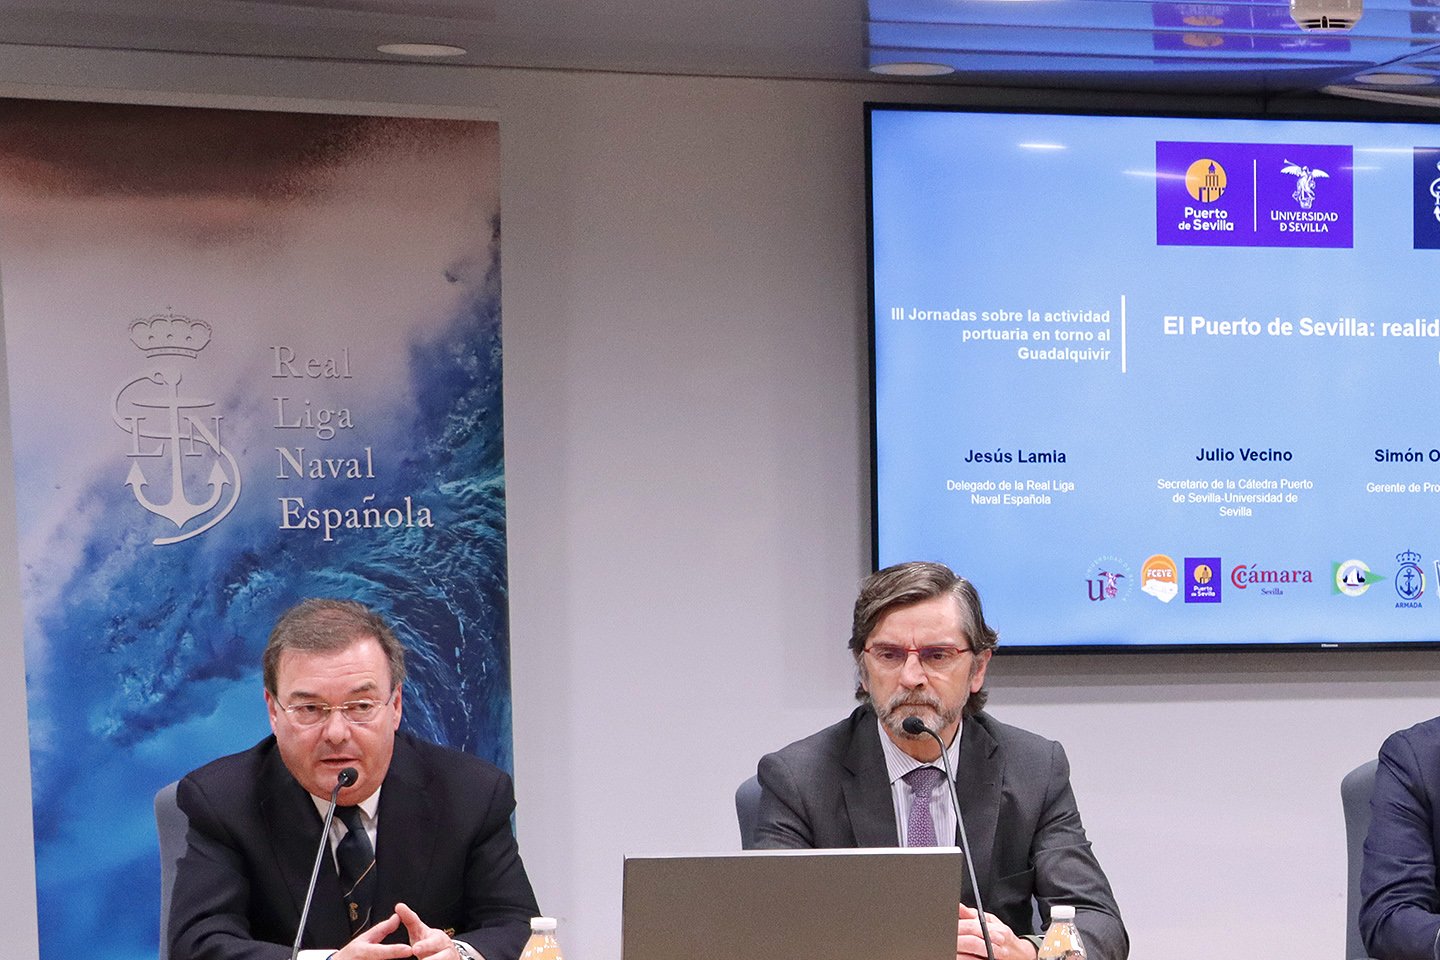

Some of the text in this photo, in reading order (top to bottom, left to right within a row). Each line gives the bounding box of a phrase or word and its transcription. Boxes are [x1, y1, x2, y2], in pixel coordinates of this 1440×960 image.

[1184, 207, 1228, 219] Puerto
[1270, 211, 1339, 222] UNIVERSIDAD
[1178, 219, 1234, 231] de Sevilla
[1289, 221, 1329, 233] SEVILLA
[891, 307, 1110, 323] III Jornadas sobre la actividad
[1164, 316, 1184, 335] El
[1191, 316, 1261, 336] Puerto
[1267, 317, 1293, 336] de
[1299, 317, 1375, 337] Sevilla:
[962, 328, 1111, 343] portuaria en torno al
[1017, 347, 1111, 363] Guadalquivir
[270, 346, 352, 380] Real
[272, 397, 354, 441] Liga
[965, 448, 1067, 464] Jesús Lamia
[1195, 448, 1293, 462] Julio Vecino
[1374, 448, 1424, 463] Simón
[275, 446, 376, 480] Naval
[946, 479, 1075, 493] Delegado de la Real Liga
[1157, 478, 1313, 490] Secretario de la Cátedra Puerto
[1366, 482, 1406, 493] Gerente
[1408, 482, 1421, 493] de
[971, 493, 1052, 507] Naval Española
[1172, 492, 1298, 504] de Sevilla-Universidad de
[278, 494, 435, 541] Española
[1219, 506, 1252, 517] Sevilla
[1261, 588, 1284, 596] Sevilla
